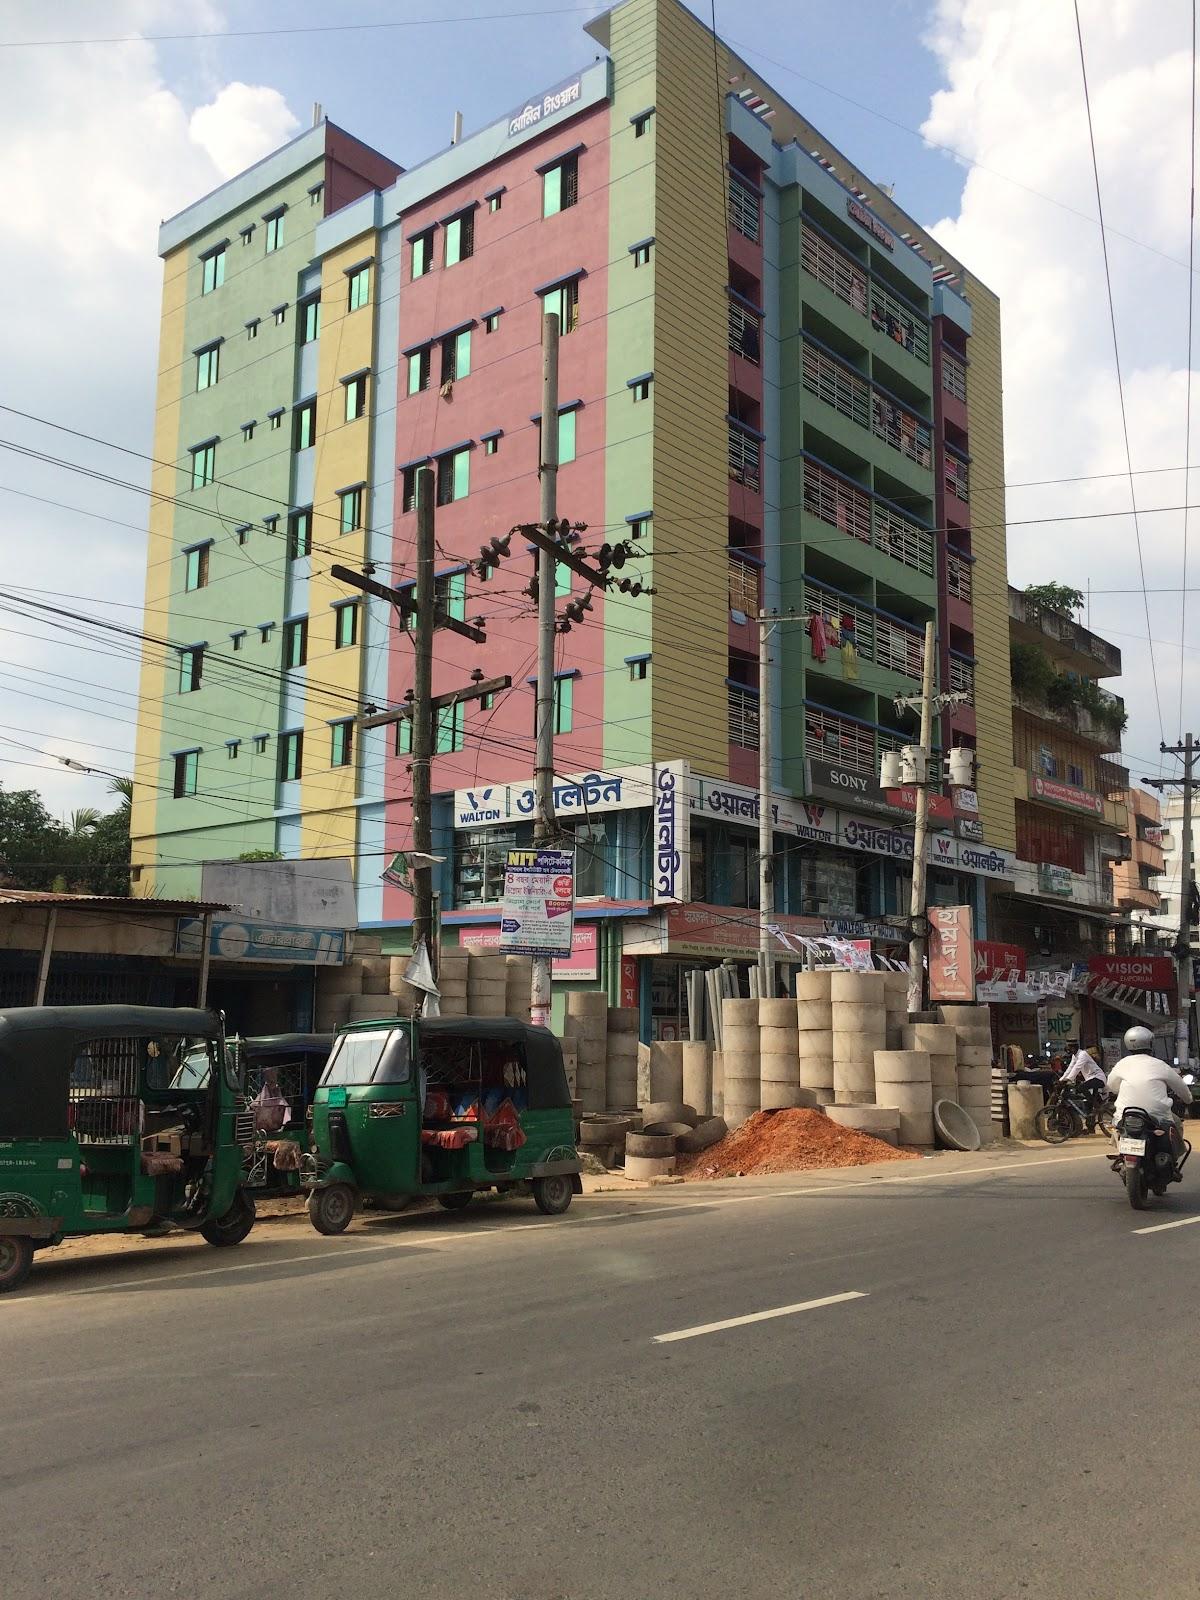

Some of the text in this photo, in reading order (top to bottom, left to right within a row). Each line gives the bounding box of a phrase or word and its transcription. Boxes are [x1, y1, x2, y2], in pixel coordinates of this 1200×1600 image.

[543, 83, 580, 116] টাওয়ার
[830, 770, 868, 792] SONY
[460, 809, 500, 824] WALTON
[658, 768, 680, 897] ওয়ালটন
[796, 823, 832, 843] WALTON
[508, 851, 538, 866] NIT
[961, 848, 1006, 874] ওয়ালটন
[836, 919, 865, 934] WALTON
[1106, 963, 1153, 975] VISION
[1120, 974, 1154, 982] EMPORIUM
